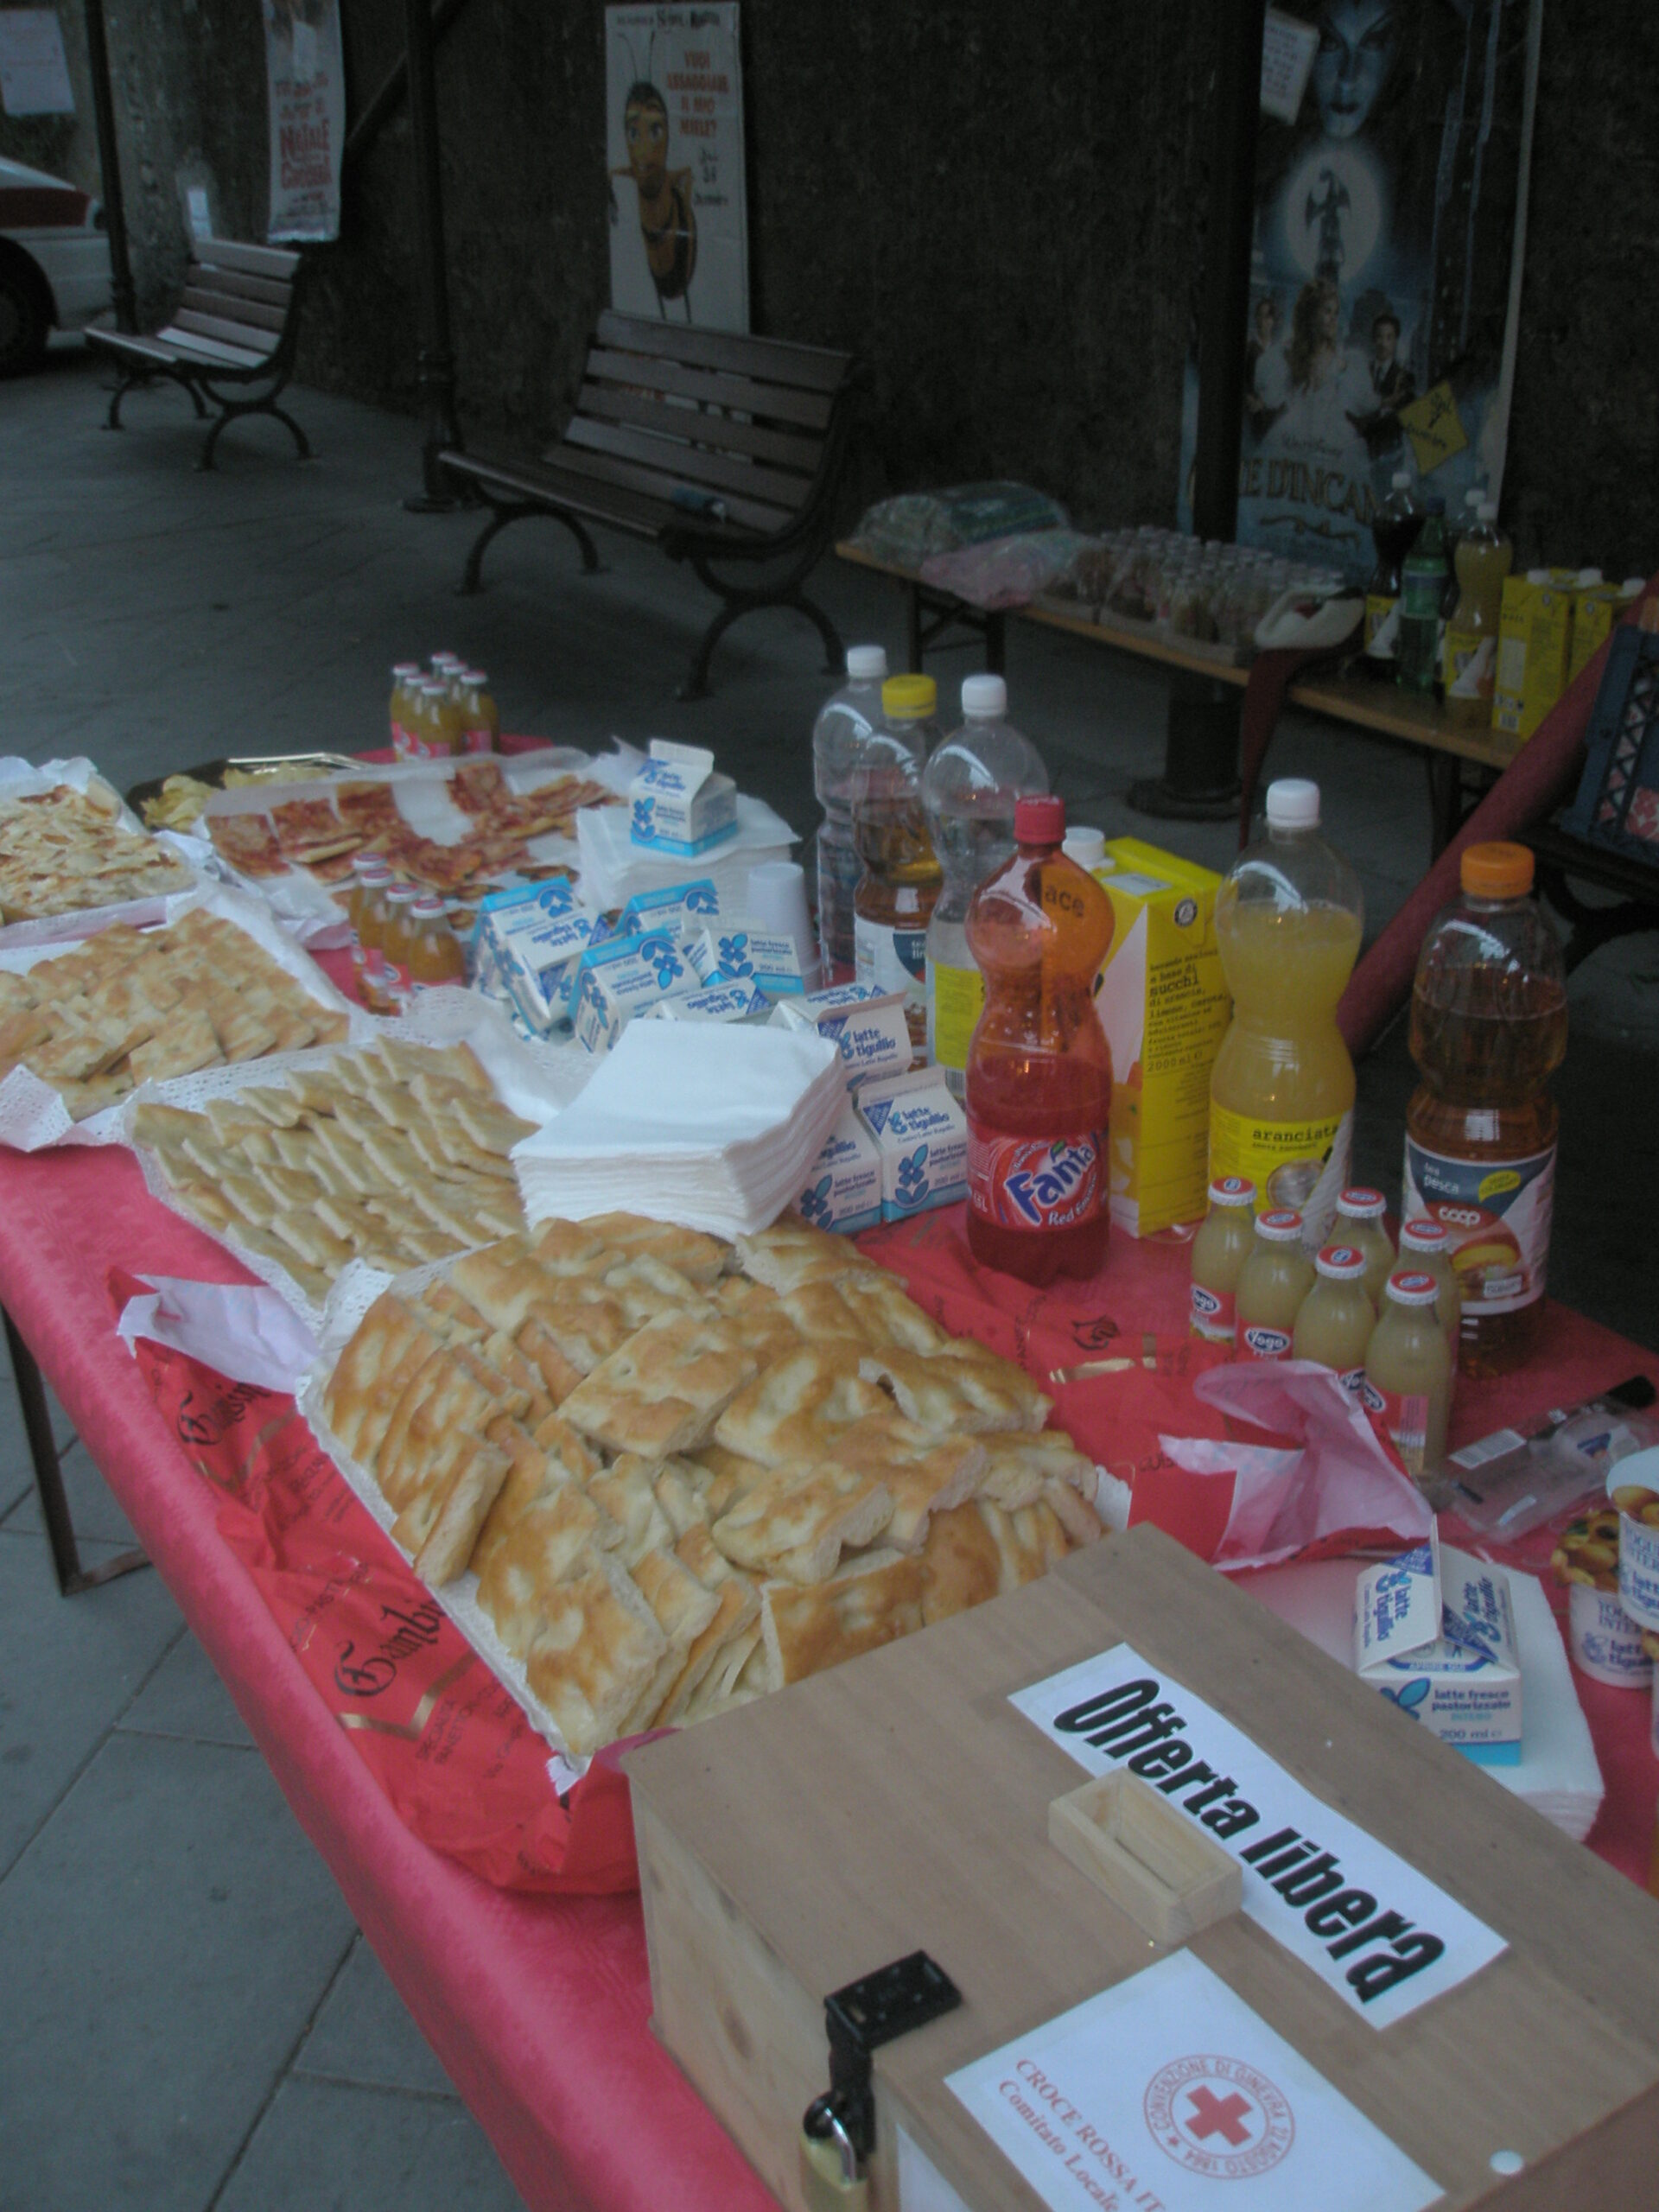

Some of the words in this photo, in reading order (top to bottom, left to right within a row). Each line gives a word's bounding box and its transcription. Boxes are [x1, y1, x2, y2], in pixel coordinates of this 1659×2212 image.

[1267, 459, 1376, 526] D'INCAN
[1045, 885, 1084, 918] ace
[1150, 974, 1198, 996] succhi
[853, 1028, 880, 1043] latte
[855, 1038, 896, 1058] tigullio
[1147, 1057, 1176, 1072] 2000
[1002, 1144, 1096, 1227] Fanta
[1423, 1176, 1459, 1195] pesca
[1047, 1207, 1075, 1226] Red
[1438, 1205, 1482, 1229] coop
[1434, 1689, 1465, 1700] latte
[1468, 1689, 1509, 1700] fresco
[1432, 1700, 1511, 1713] pastorizzato
[1439, 1729, 1466, 1738] 200
[1053, 1678, 1261, 1840] Offerta
[1239, 1826, 1446, 2005] libera
[1016, 2058, 1082, 2126] CROCE
[1075, 2123, 1137, 2194] ROSSA
[999, 2079, 1067, 2156] Comitato
[1065, 2153, 1119, 2212] Locale
